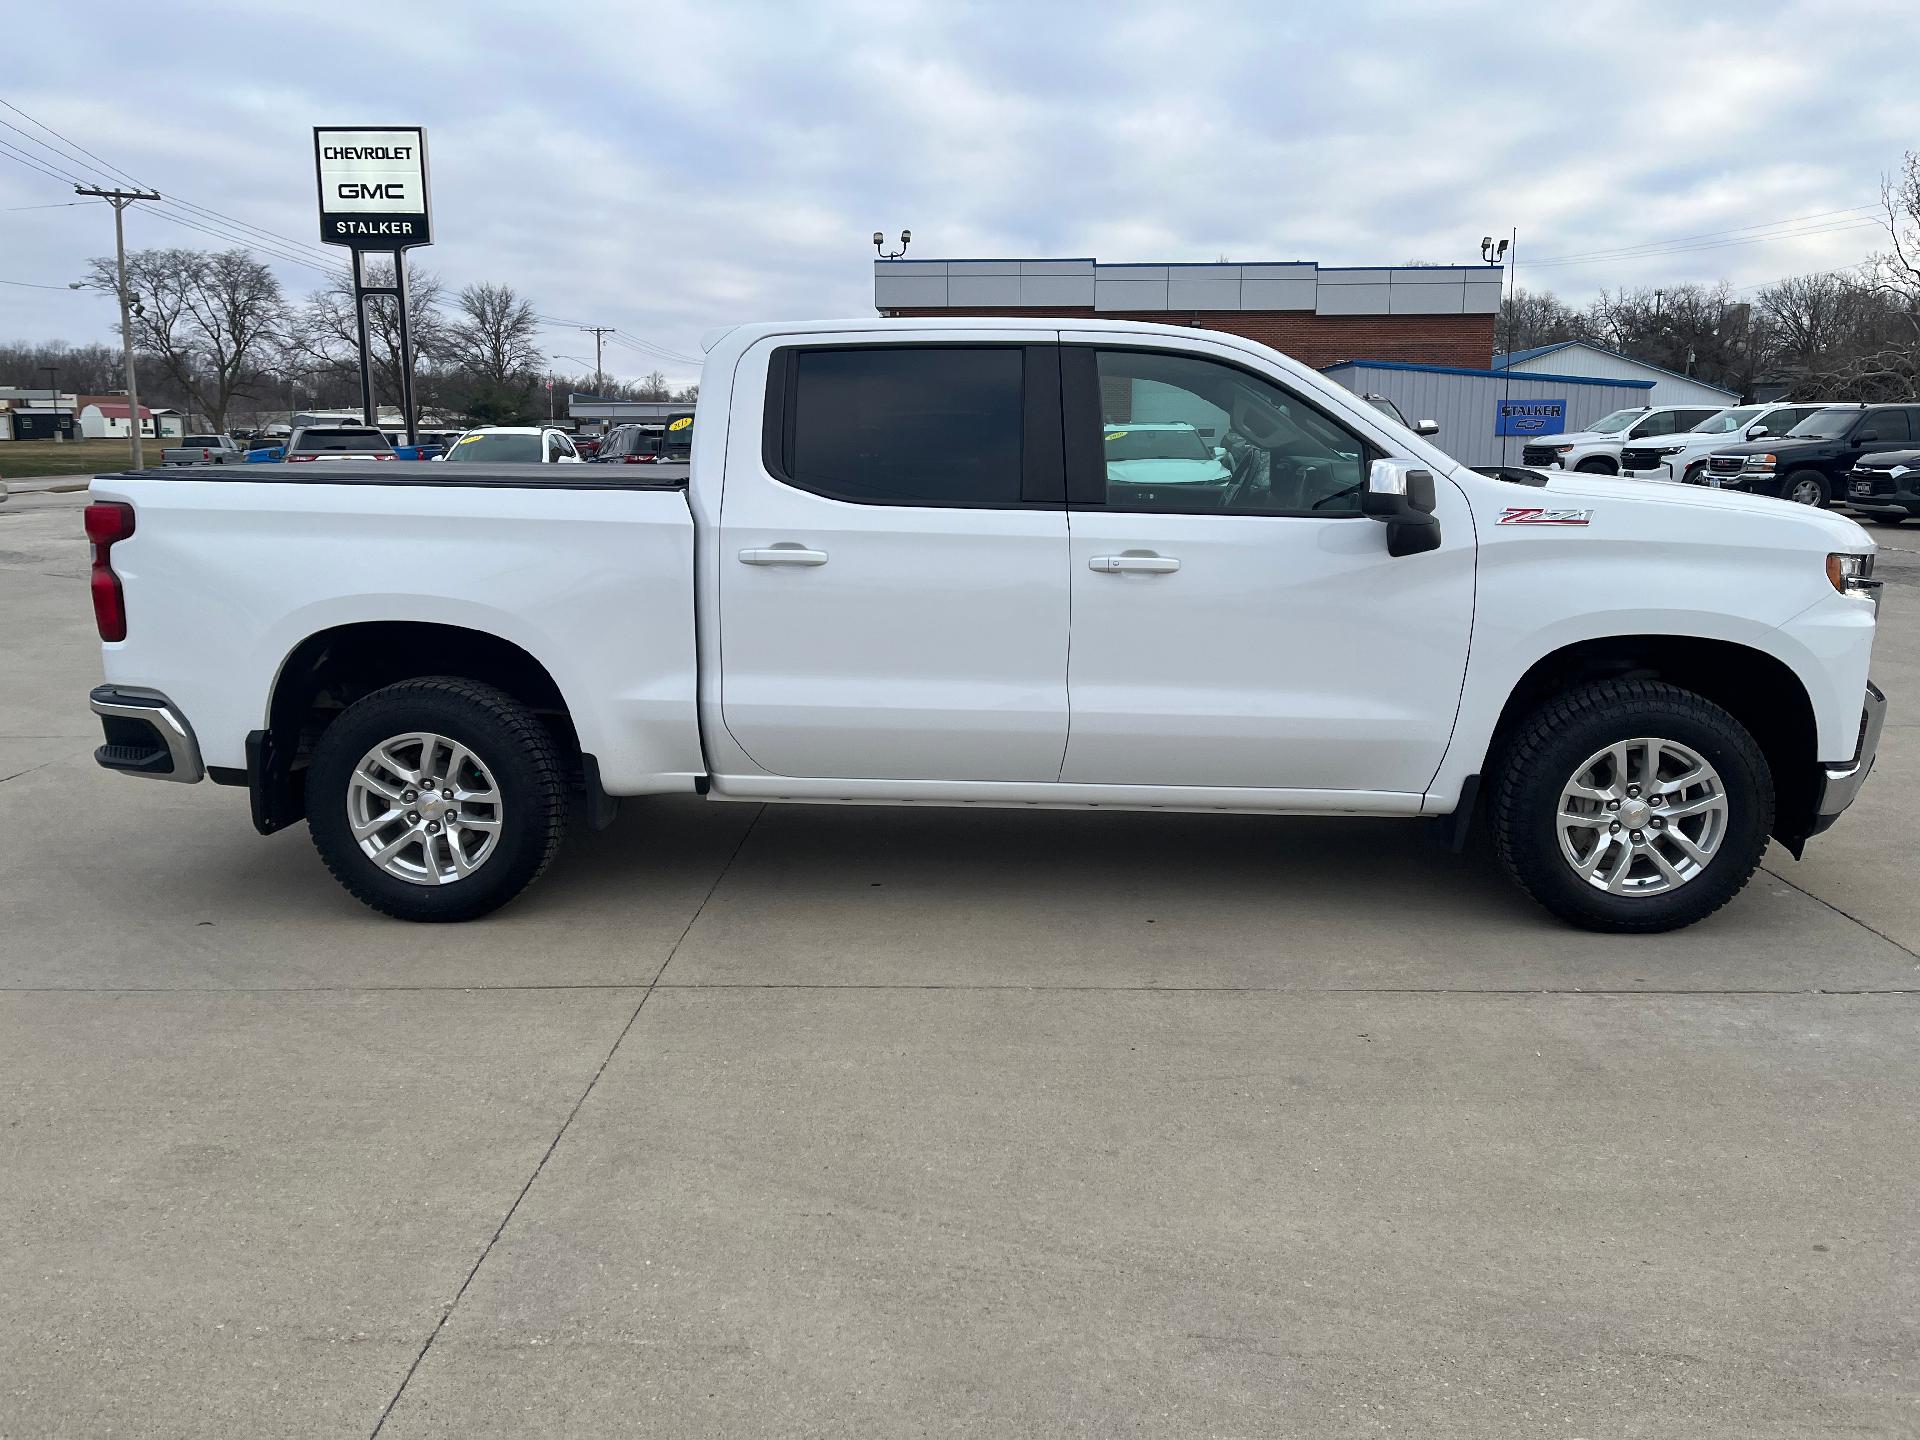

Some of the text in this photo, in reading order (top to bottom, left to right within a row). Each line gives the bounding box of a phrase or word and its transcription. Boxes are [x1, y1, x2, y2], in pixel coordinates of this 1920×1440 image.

[324, 147, 412, 160] CHEVROLET
[338, 183, 405, 199] GMC
[336, 221, 413, 234] STALKER
[1501, 405, 1561, 417] STALKER
[1496, 507, 1595, 525] Z71
